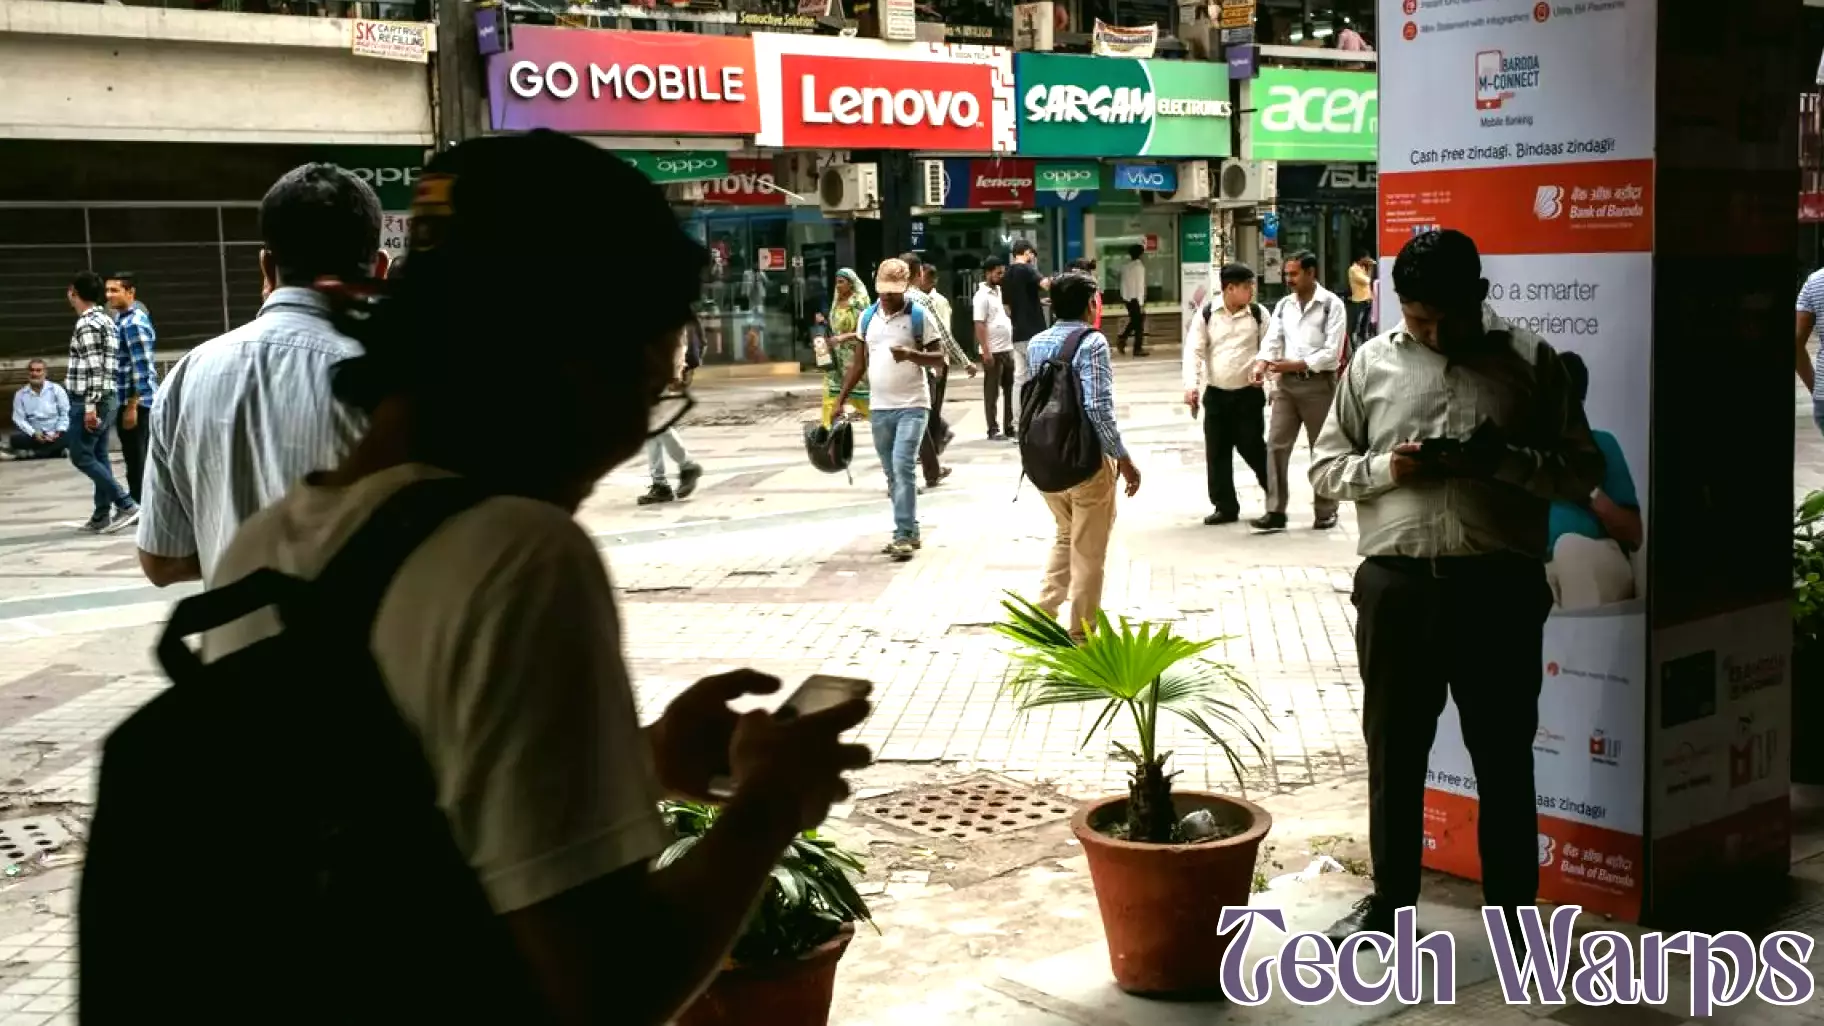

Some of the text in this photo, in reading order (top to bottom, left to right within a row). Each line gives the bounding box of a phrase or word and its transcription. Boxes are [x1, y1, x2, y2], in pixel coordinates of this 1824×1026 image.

[356, 22, 376, 41] SK
[1503, 55, 1539, 72] BARODA
[509, 60, 746, 102] GO MOBILE
[1479, 71, 1539, 91] M-CONNECT
[802, 74, 980, 128] Lenovo
[1025, 84, 1232, 125] SARGAM ELECTRONICS
[1262, 85, 1377, 133] acer
[1505, 115, 1533, 127] Banking
[1410, 150, 1438, 166] Cash
[1440, 149, 1465, 164] free
[1516, 141, 1563, 159] Bindaas
[656, 156, 718, 174] oppo
[352, 166, 423, 187] opp
[974, 173, 1033, 189] lenovo
[1042, 168, 1092, 183] oppo
[1126, 171, 1164, 186] vivo
[1570, 203, 1644, 218] Bank of Baroda
[384, 236, 401, 249] 4G
[1488, 279, 1599, 301] o a smarter
[1437, 770, 1462, 788] free
[1561, 860, 1585, 876] Bank
[1586, 868, 1598, 879] of
[1598, 868, 1635, 888] Baroda
